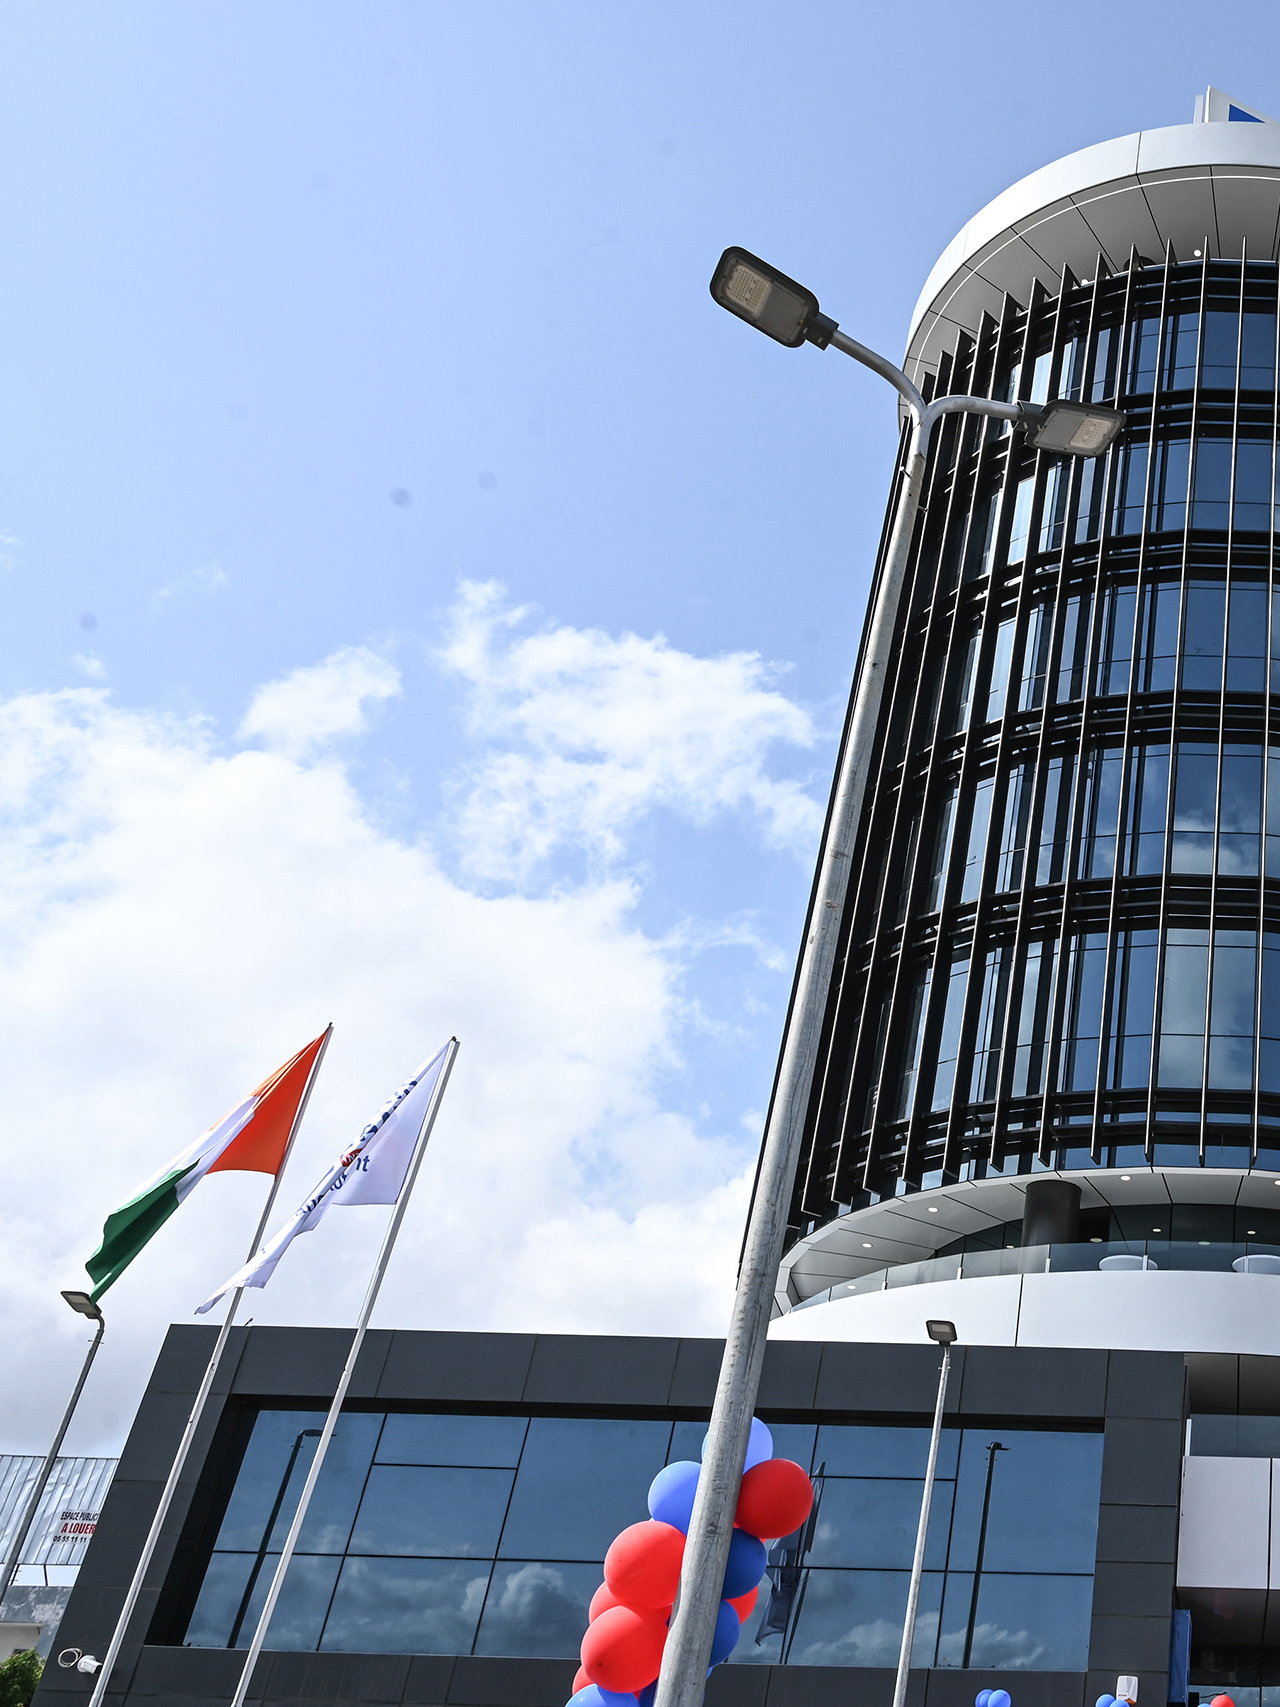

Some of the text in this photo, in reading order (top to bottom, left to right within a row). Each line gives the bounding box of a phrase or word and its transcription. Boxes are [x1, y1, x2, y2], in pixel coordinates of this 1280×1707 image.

[61, 1512, 79, 1520] ESPACE
[61, 1523, 96, 1534] A LOUER
